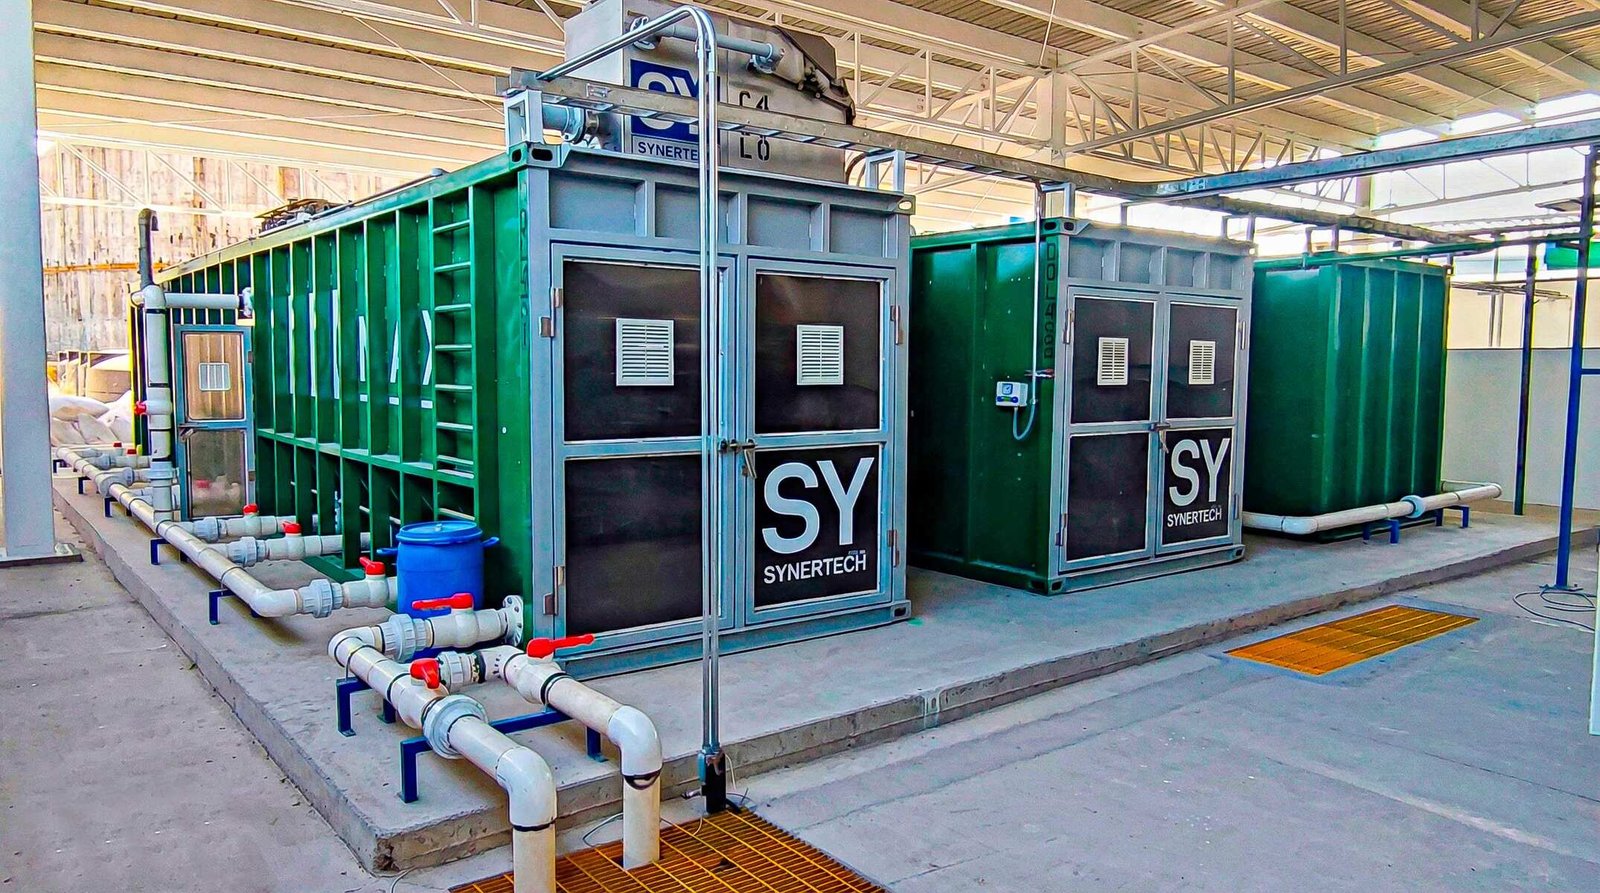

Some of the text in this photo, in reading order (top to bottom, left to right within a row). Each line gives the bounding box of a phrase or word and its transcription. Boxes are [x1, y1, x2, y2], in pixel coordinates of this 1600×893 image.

[1168, 438, 1231, 507] SY
[762, 457, 875, 555] SY
[1167, 507, 1222, 527] SYNERTECH
[763, 554, 867, 584] SYNERTECH
